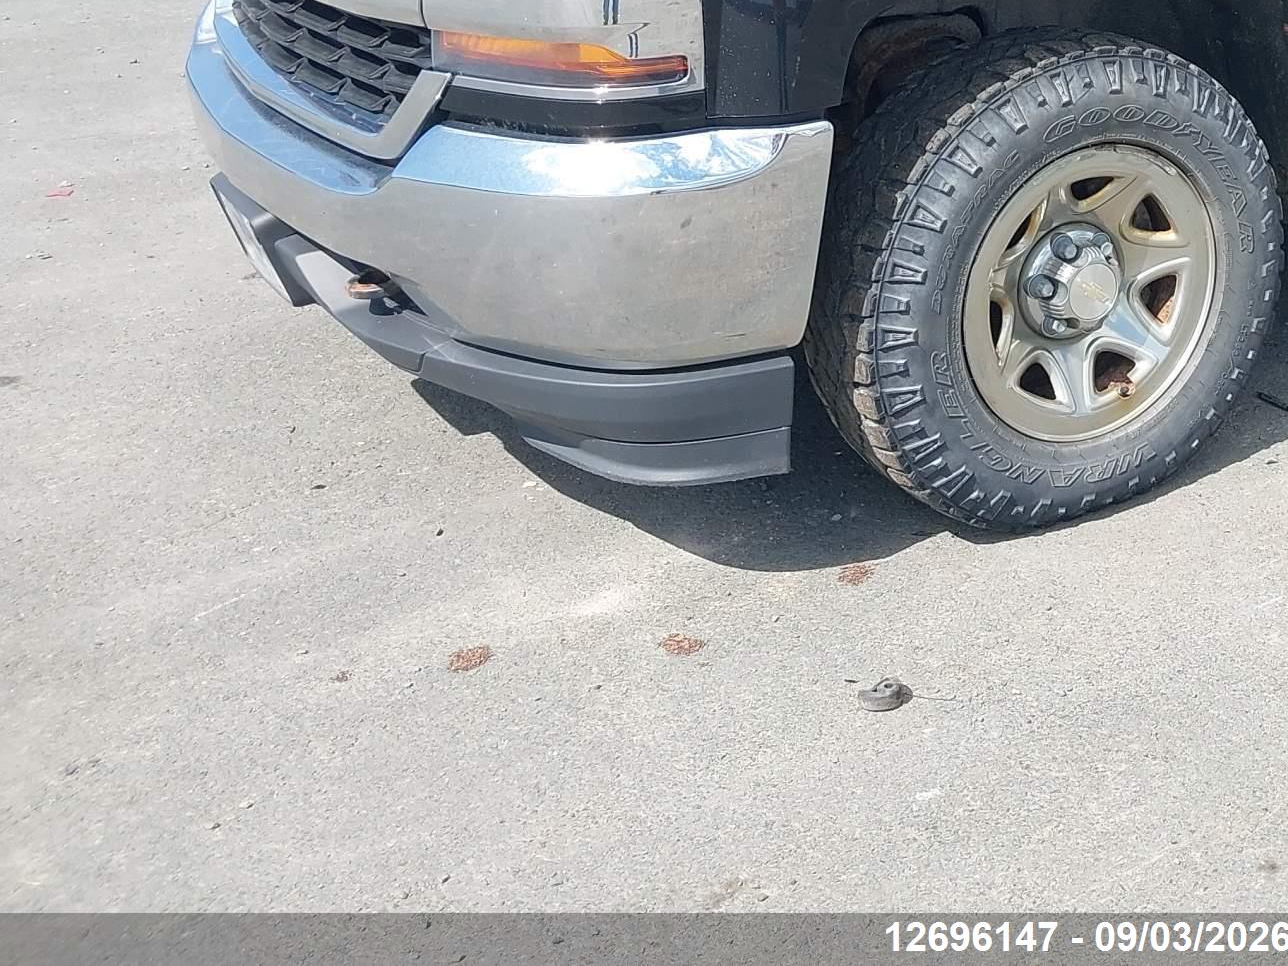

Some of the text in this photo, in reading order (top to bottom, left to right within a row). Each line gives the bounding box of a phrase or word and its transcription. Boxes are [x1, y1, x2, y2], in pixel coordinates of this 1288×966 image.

[931, 149, 1021, 315] DURATRAC
[1044, 103, 1256, 255] GOODYEAR
[930, 350, 1157, 488] WRANGLER
